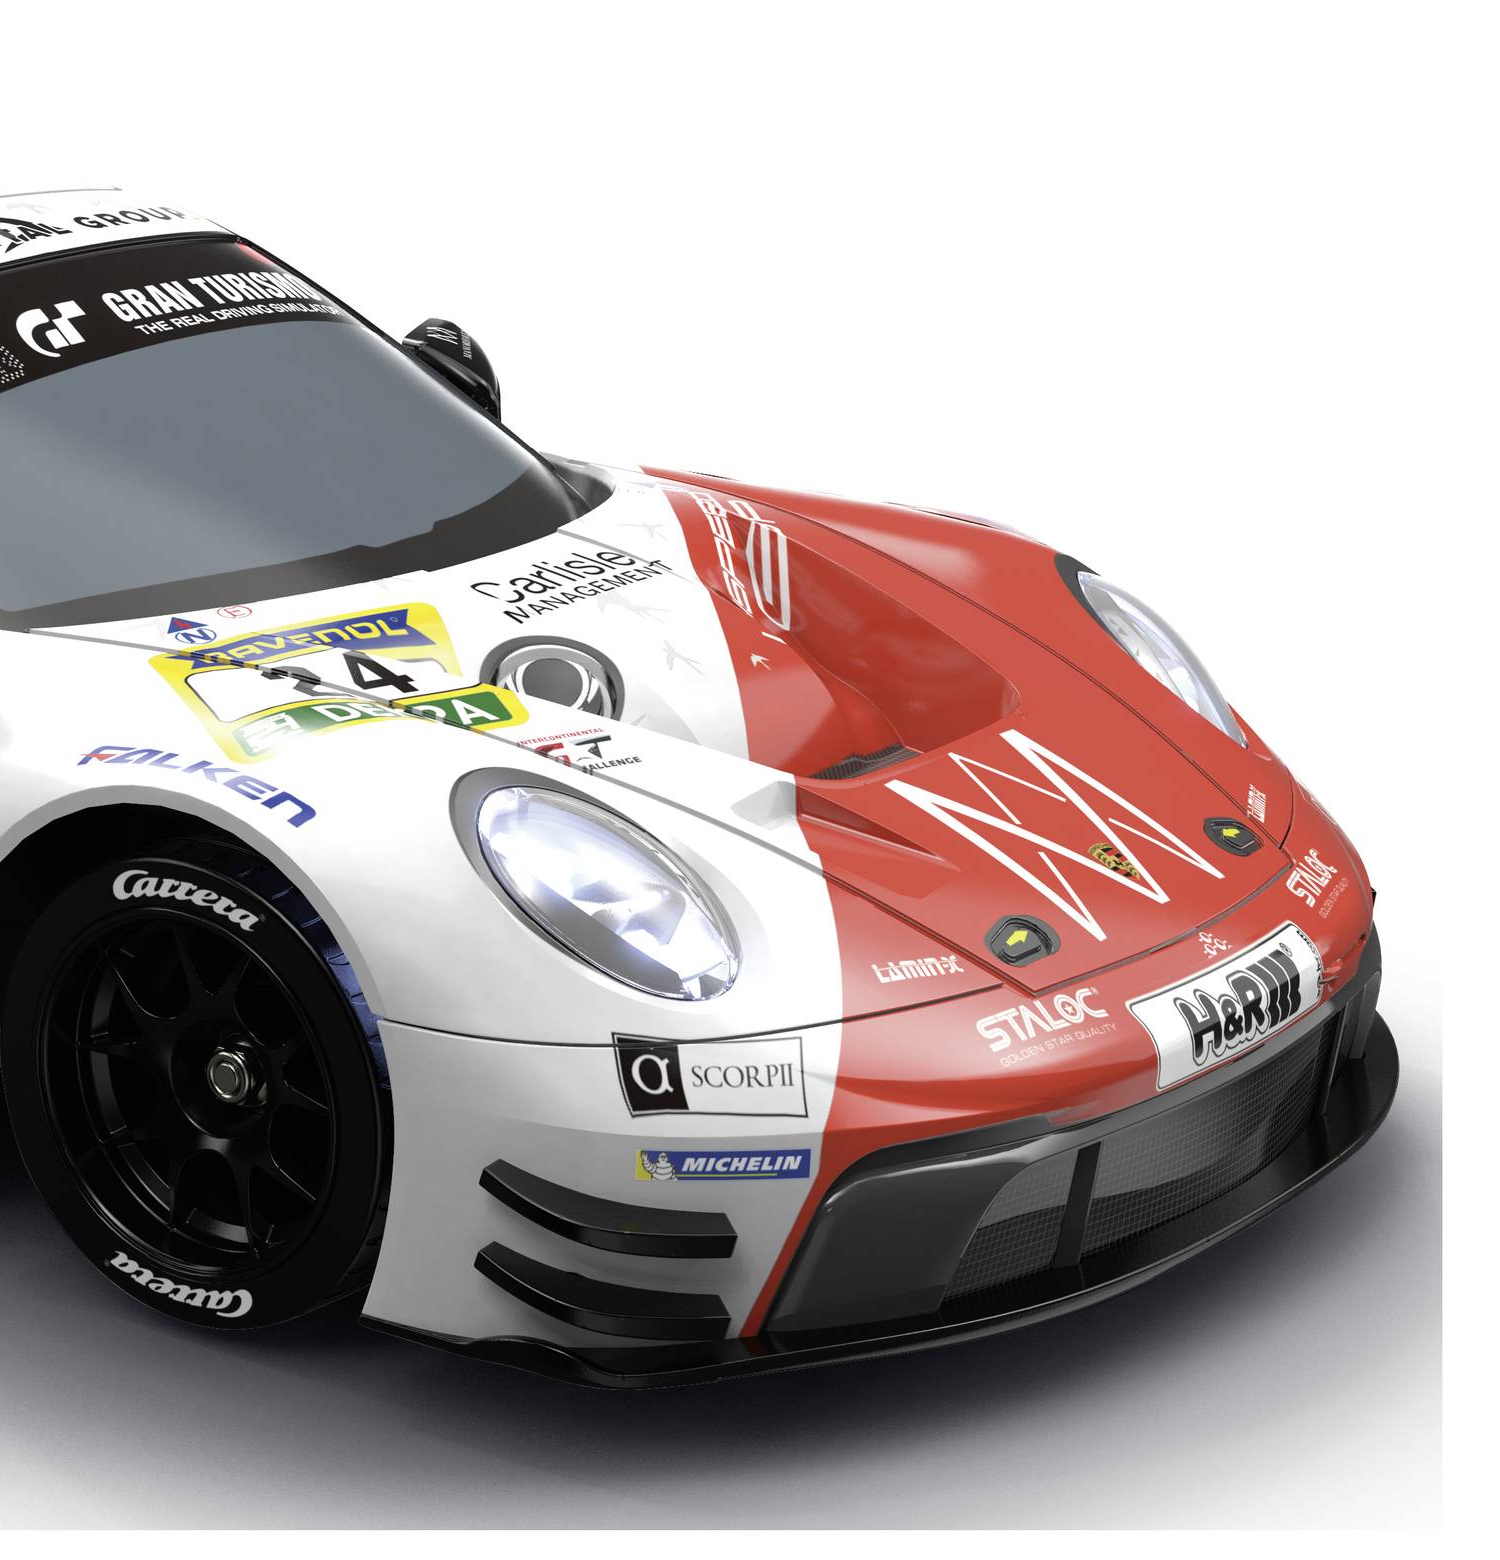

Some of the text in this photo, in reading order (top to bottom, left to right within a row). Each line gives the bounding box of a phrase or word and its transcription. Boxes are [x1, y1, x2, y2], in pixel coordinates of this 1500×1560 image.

[102, 271, 322, 323] GRAN TURISMO
[133, 320, 173, 337] THE
[176, 310, 216, 329] REAL
[216, 302, 274, 322] DRIVING
[470, 551, 636, 603] Carlisle
[503, 560, 673, 624] MANAGEMENT
[77, 745, 316, 828] FALKEN
[112, 869, 260, 932] Carrera
[1285, 848, 1338, 908] STALOC
[976, 987, 1110, 1053] STALOC
[691, 1063, 795, 1088] SCORPII
[999, 1043, 1045, 1068] GOLDEN
[1044, 1033, 1075, 1050] STAR
[681, 1155, 803, 1173] MICHELIN
[110, 1250, 253, 1318] Carrera
